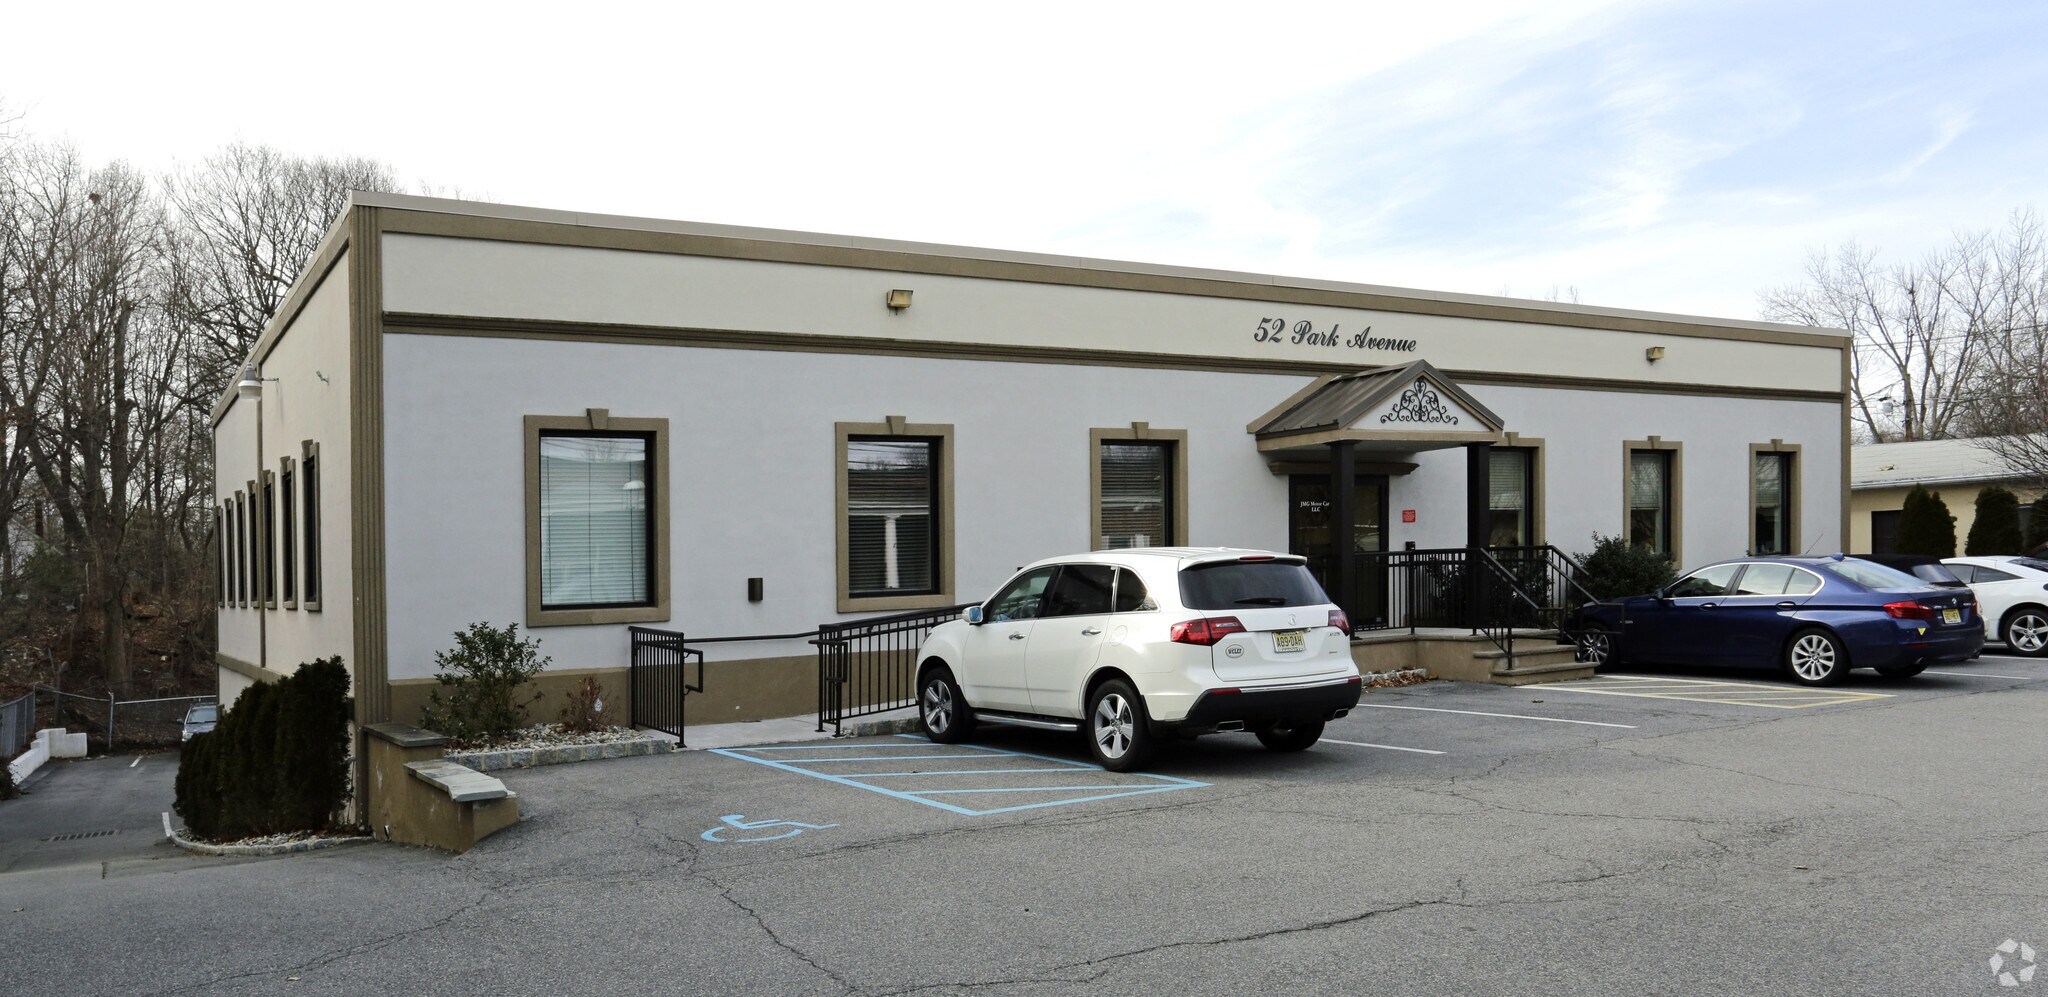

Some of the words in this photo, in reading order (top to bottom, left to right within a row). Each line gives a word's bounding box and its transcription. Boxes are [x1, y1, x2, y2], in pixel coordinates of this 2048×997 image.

[1254, 317, 1285, 343] 52
[1291, 320, 1339, 347] Park
[1347, 326, 1416, 352] Avenue
